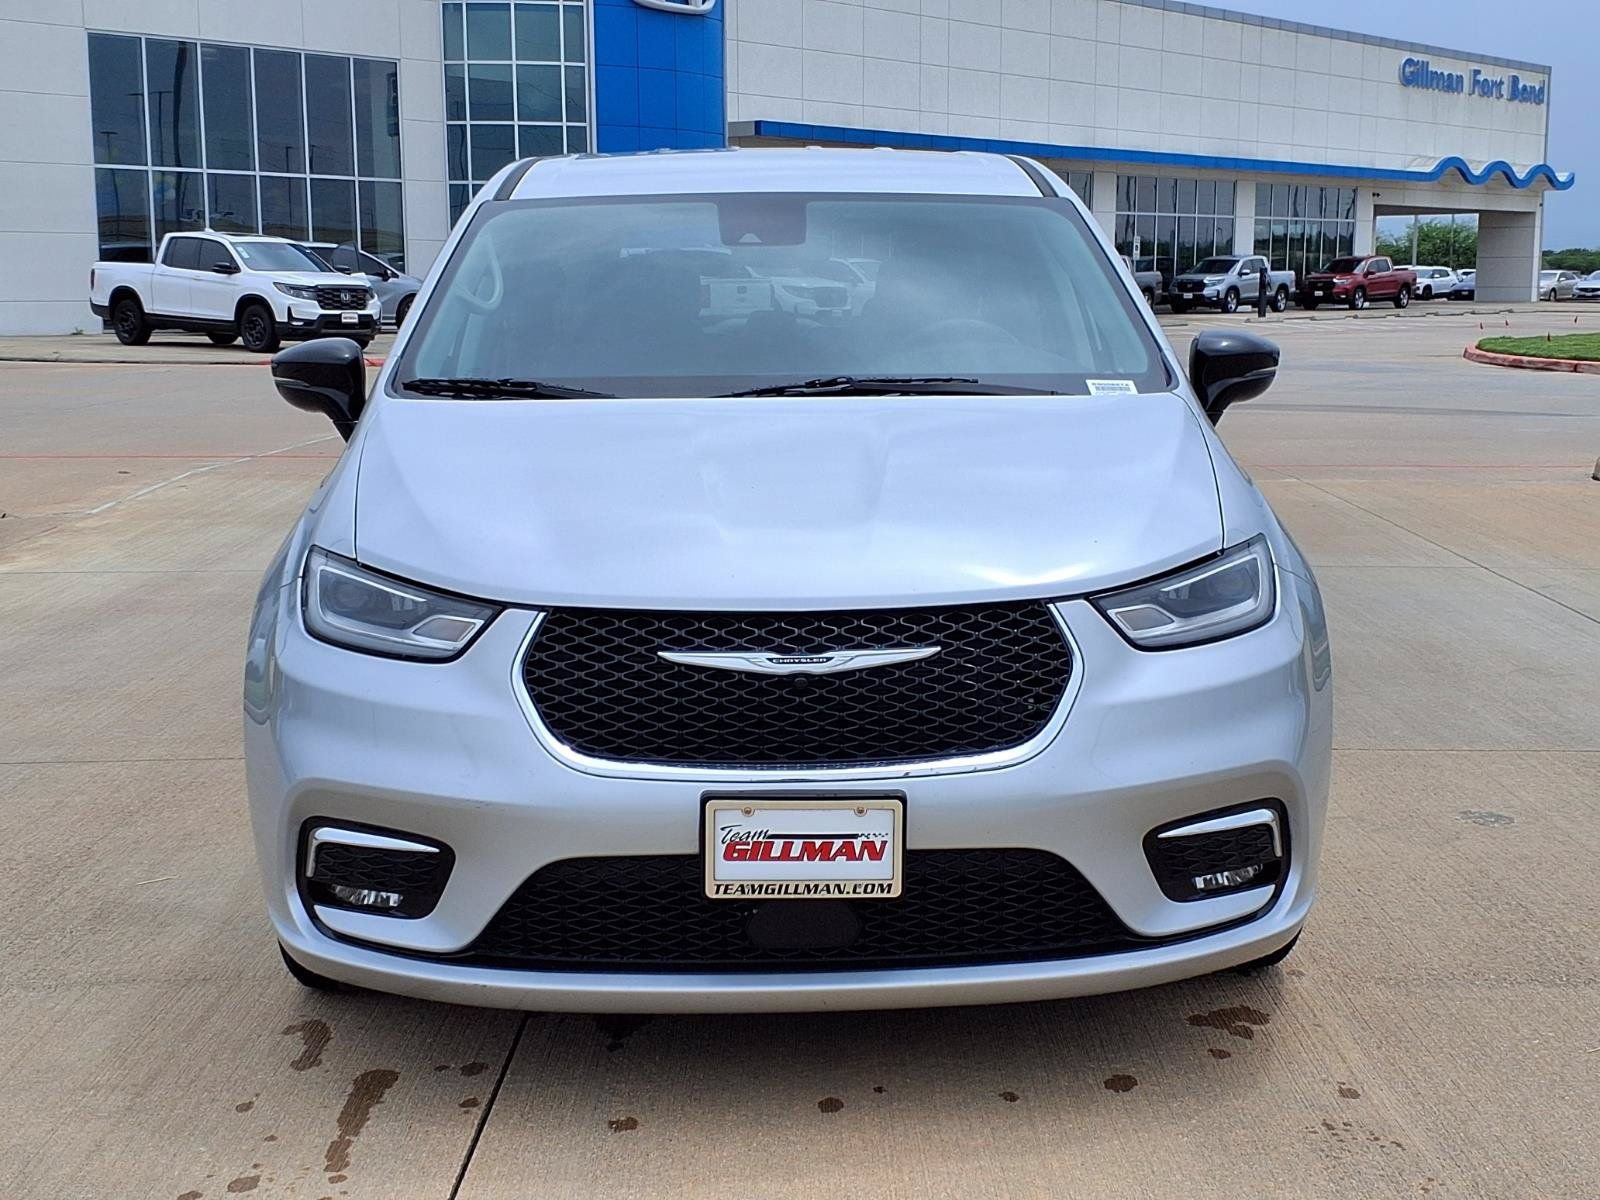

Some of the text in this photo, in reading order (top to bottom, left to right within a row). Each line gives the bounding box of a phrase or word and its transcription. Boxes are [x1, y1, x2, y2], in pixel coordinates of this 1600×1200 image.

[1400, 58, 1546, 105] Gillman Fort Bend
[720, 825, 769, 844] Team
[723, 840, 888, 862] GILLMAN
[714, 883, 893, 895] TEAMGILLMAN.COM
